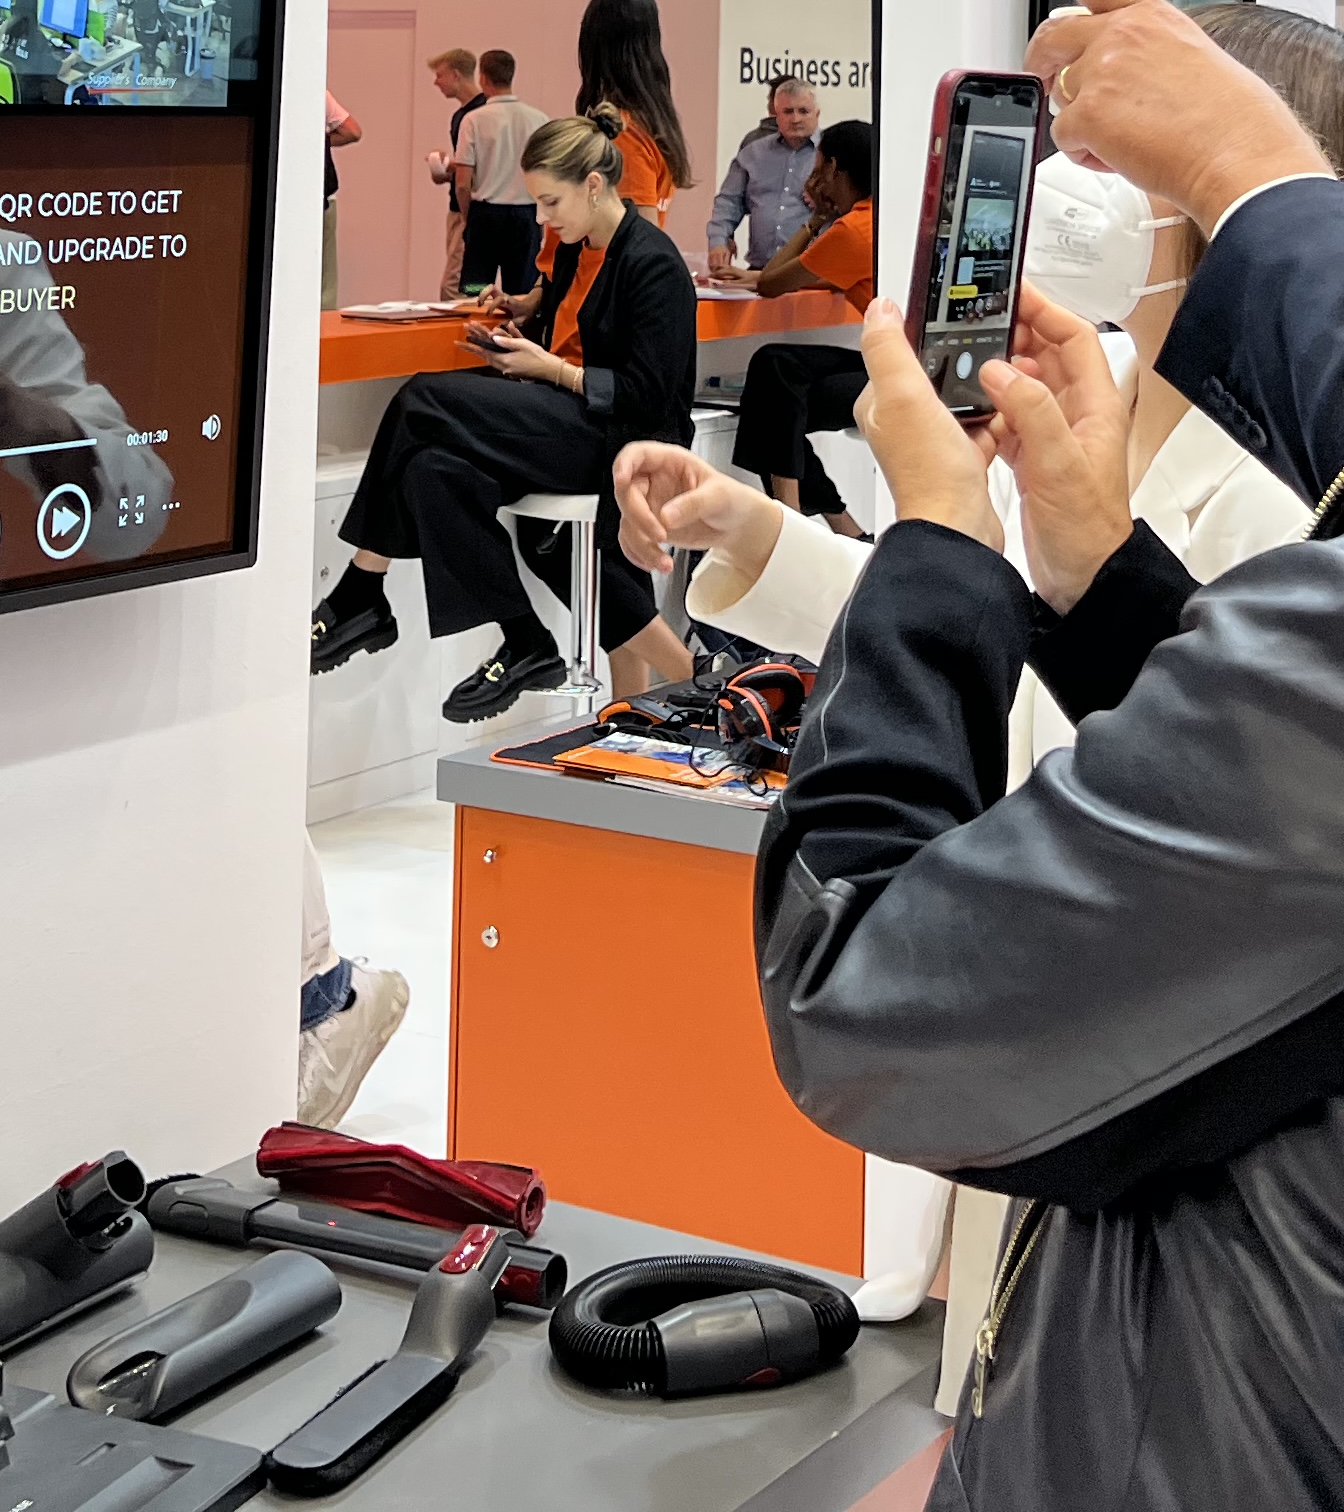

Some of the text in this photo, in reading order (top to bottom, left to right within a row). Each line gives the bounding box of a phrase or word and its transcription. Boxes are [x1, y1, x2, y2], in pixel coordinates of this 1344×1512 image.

[136, 73, 178, 89] Company
[740, 47, 872, 88] Business ar
[38, 191, 103, 217] CODE
[107, 190, 138, 215] TO
[141, 190, 183, 214] GET
[48, 235, 155, 264] UPGRADE
[158, 234, 188, 258] TO
[0, 286, 77, 314] BUYER
[126, 429, 169, 447] 00:01:30
